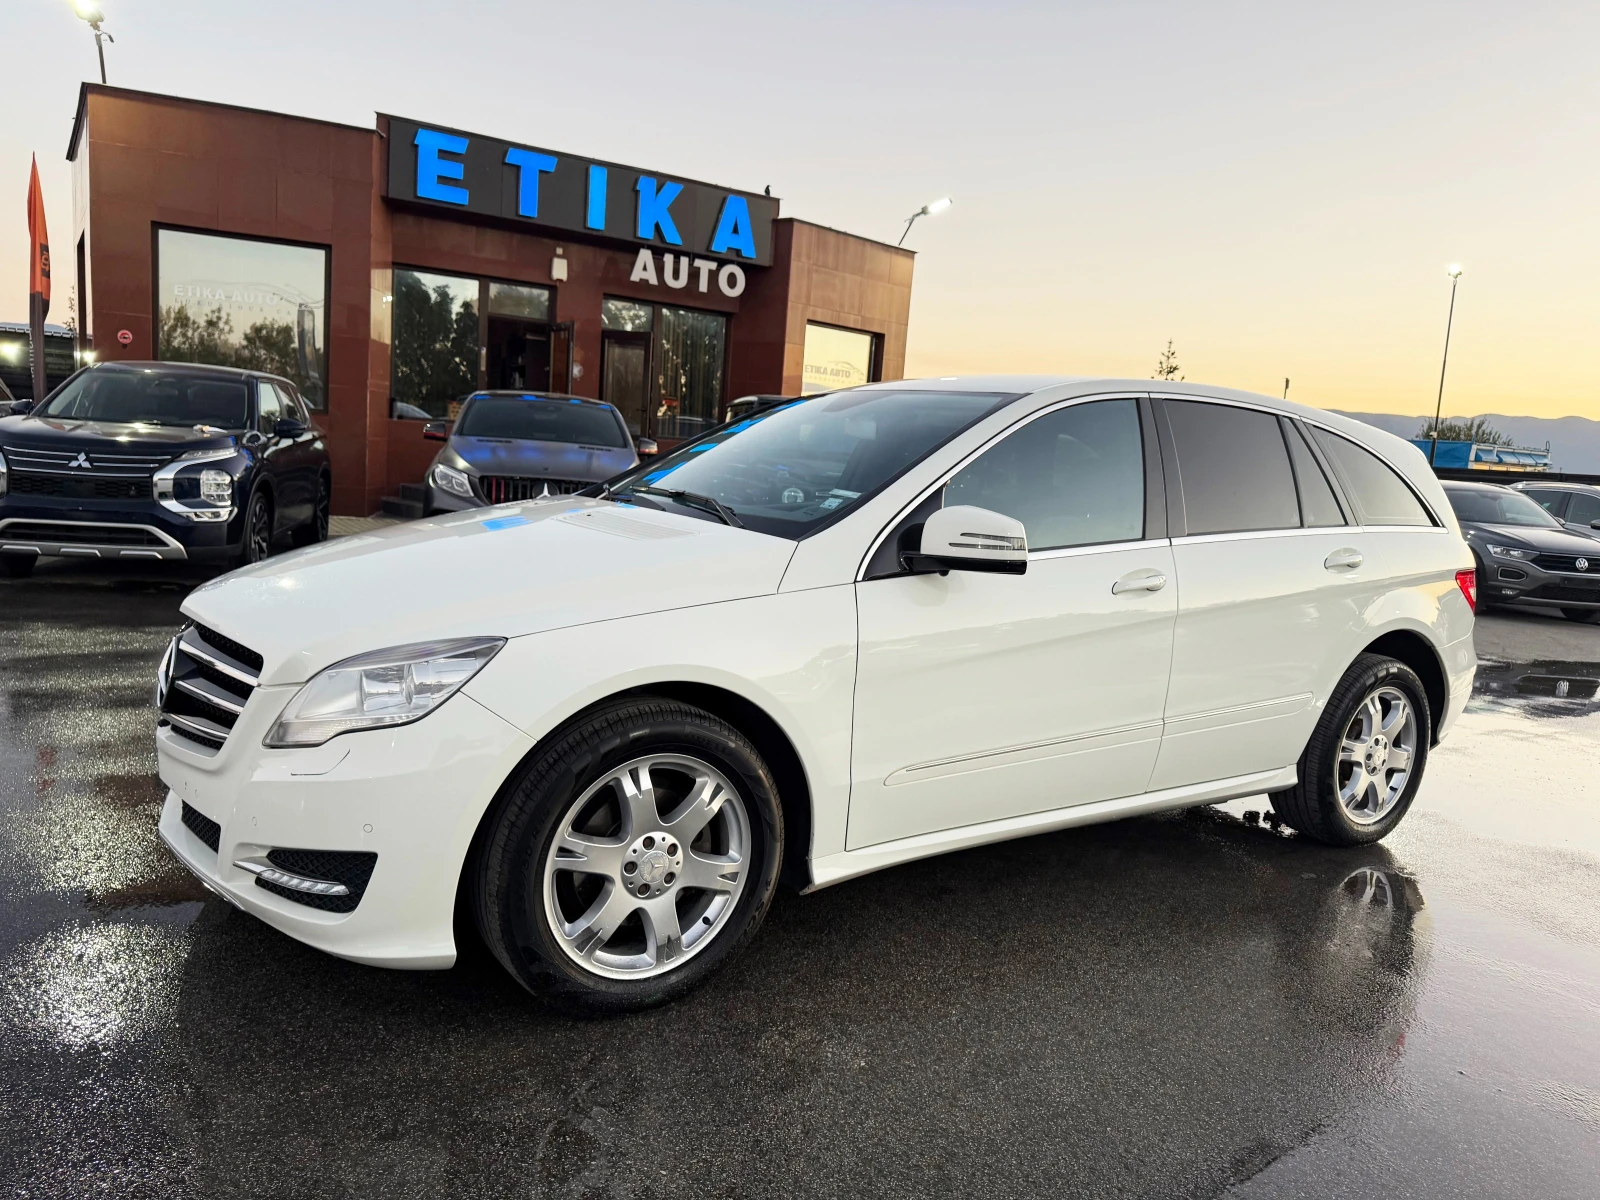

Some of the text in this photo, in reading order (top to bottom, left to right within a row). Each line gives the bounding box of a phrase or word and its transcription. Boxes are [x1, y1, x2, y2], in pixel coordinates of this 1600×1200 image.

[413, 127, 758, 260] ETIKA
[630, 248, 746, 298] AUTO
[173, 284, 279, 307] ETIKA AUTO
[804, 364, 851, 379] ETIKA AUTO
